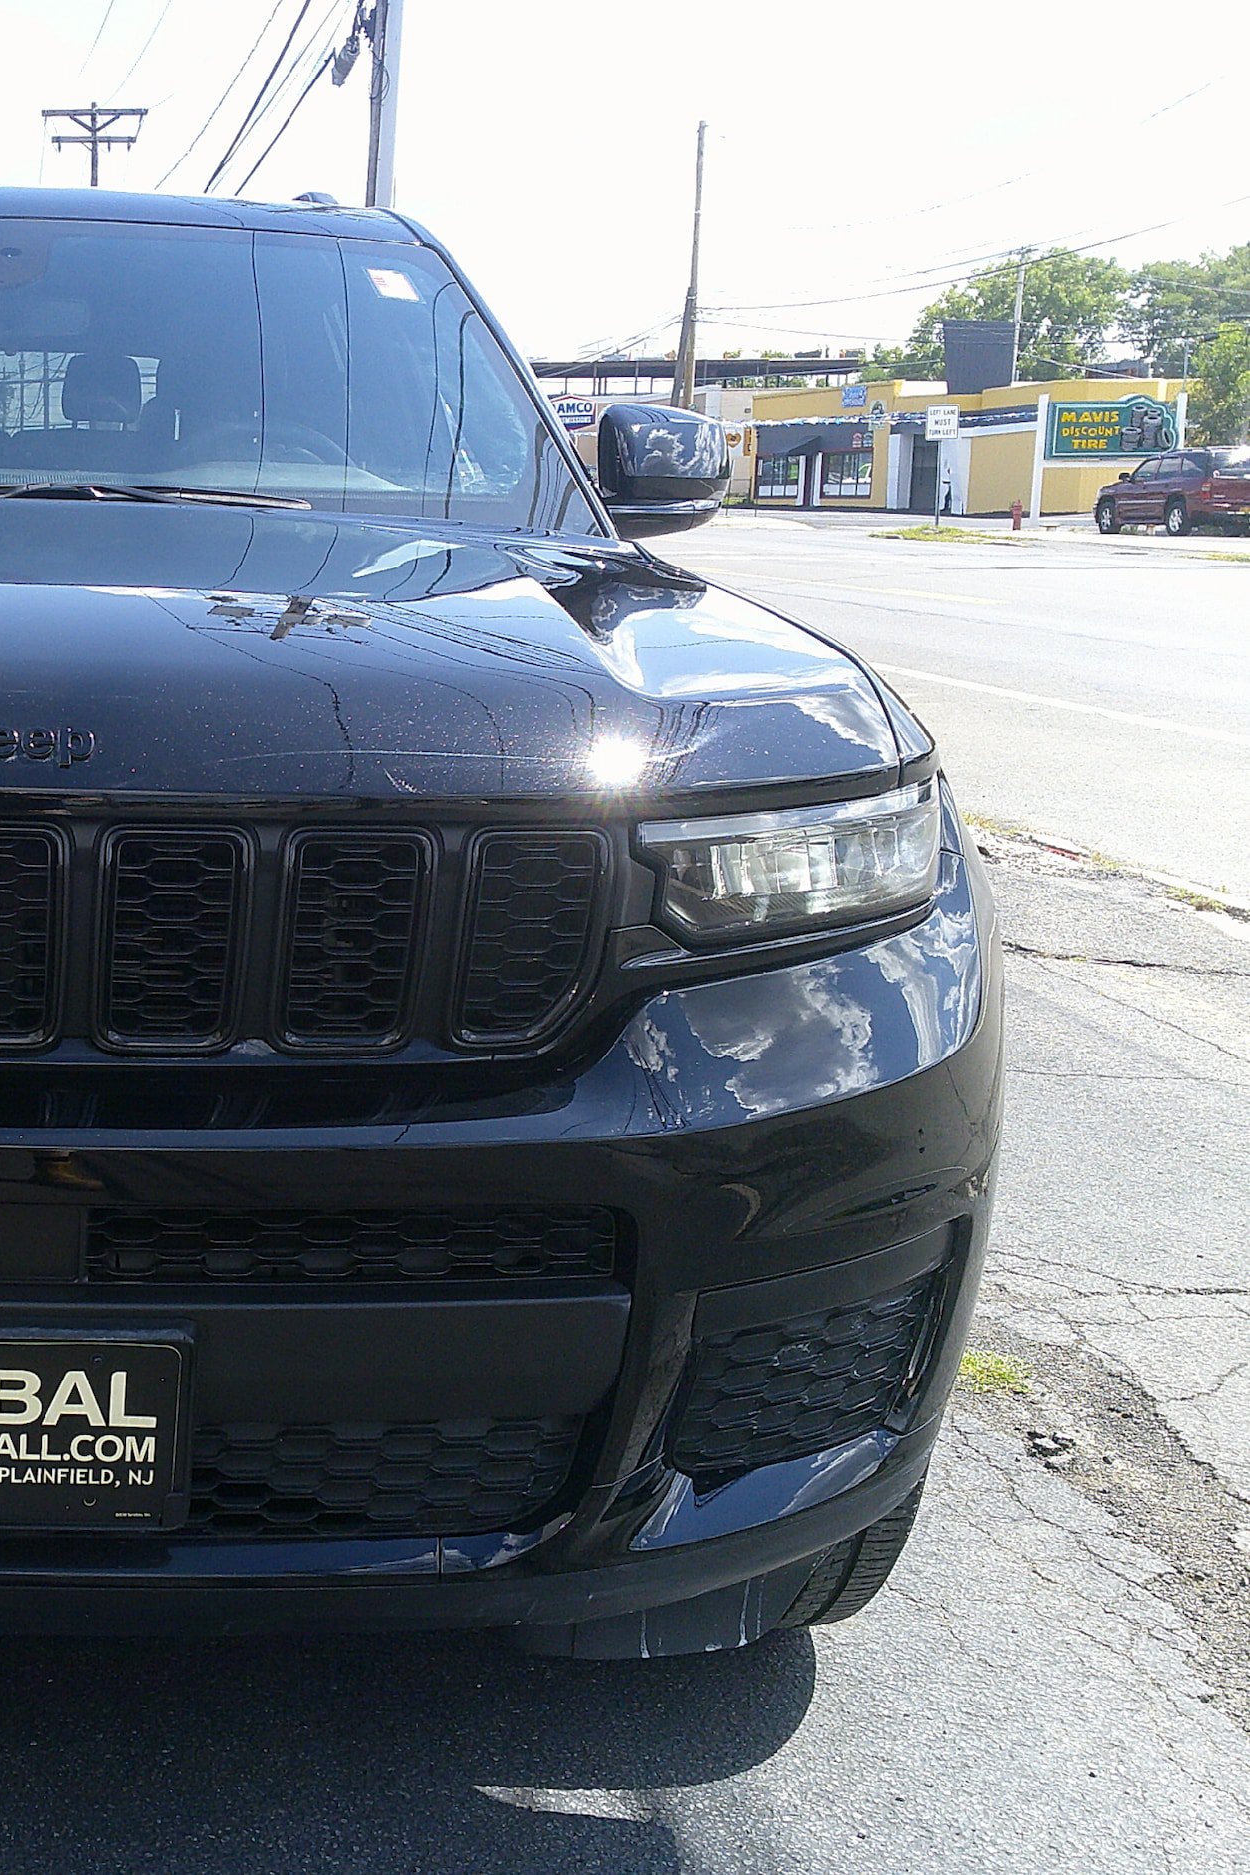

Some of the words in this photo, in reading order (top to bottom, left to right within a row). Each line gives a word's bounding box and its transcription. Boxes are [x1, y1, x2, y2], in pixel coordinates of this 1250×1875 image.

[553, 402, 593, 413] AMCO
[1061, 411, 1119, 422] MAVIS
[1062, 426, 1120, 437] DISCOUNT
[1072, 439, 1108, 449] TIRE
[128, 1469, 154, 1486] NJ
